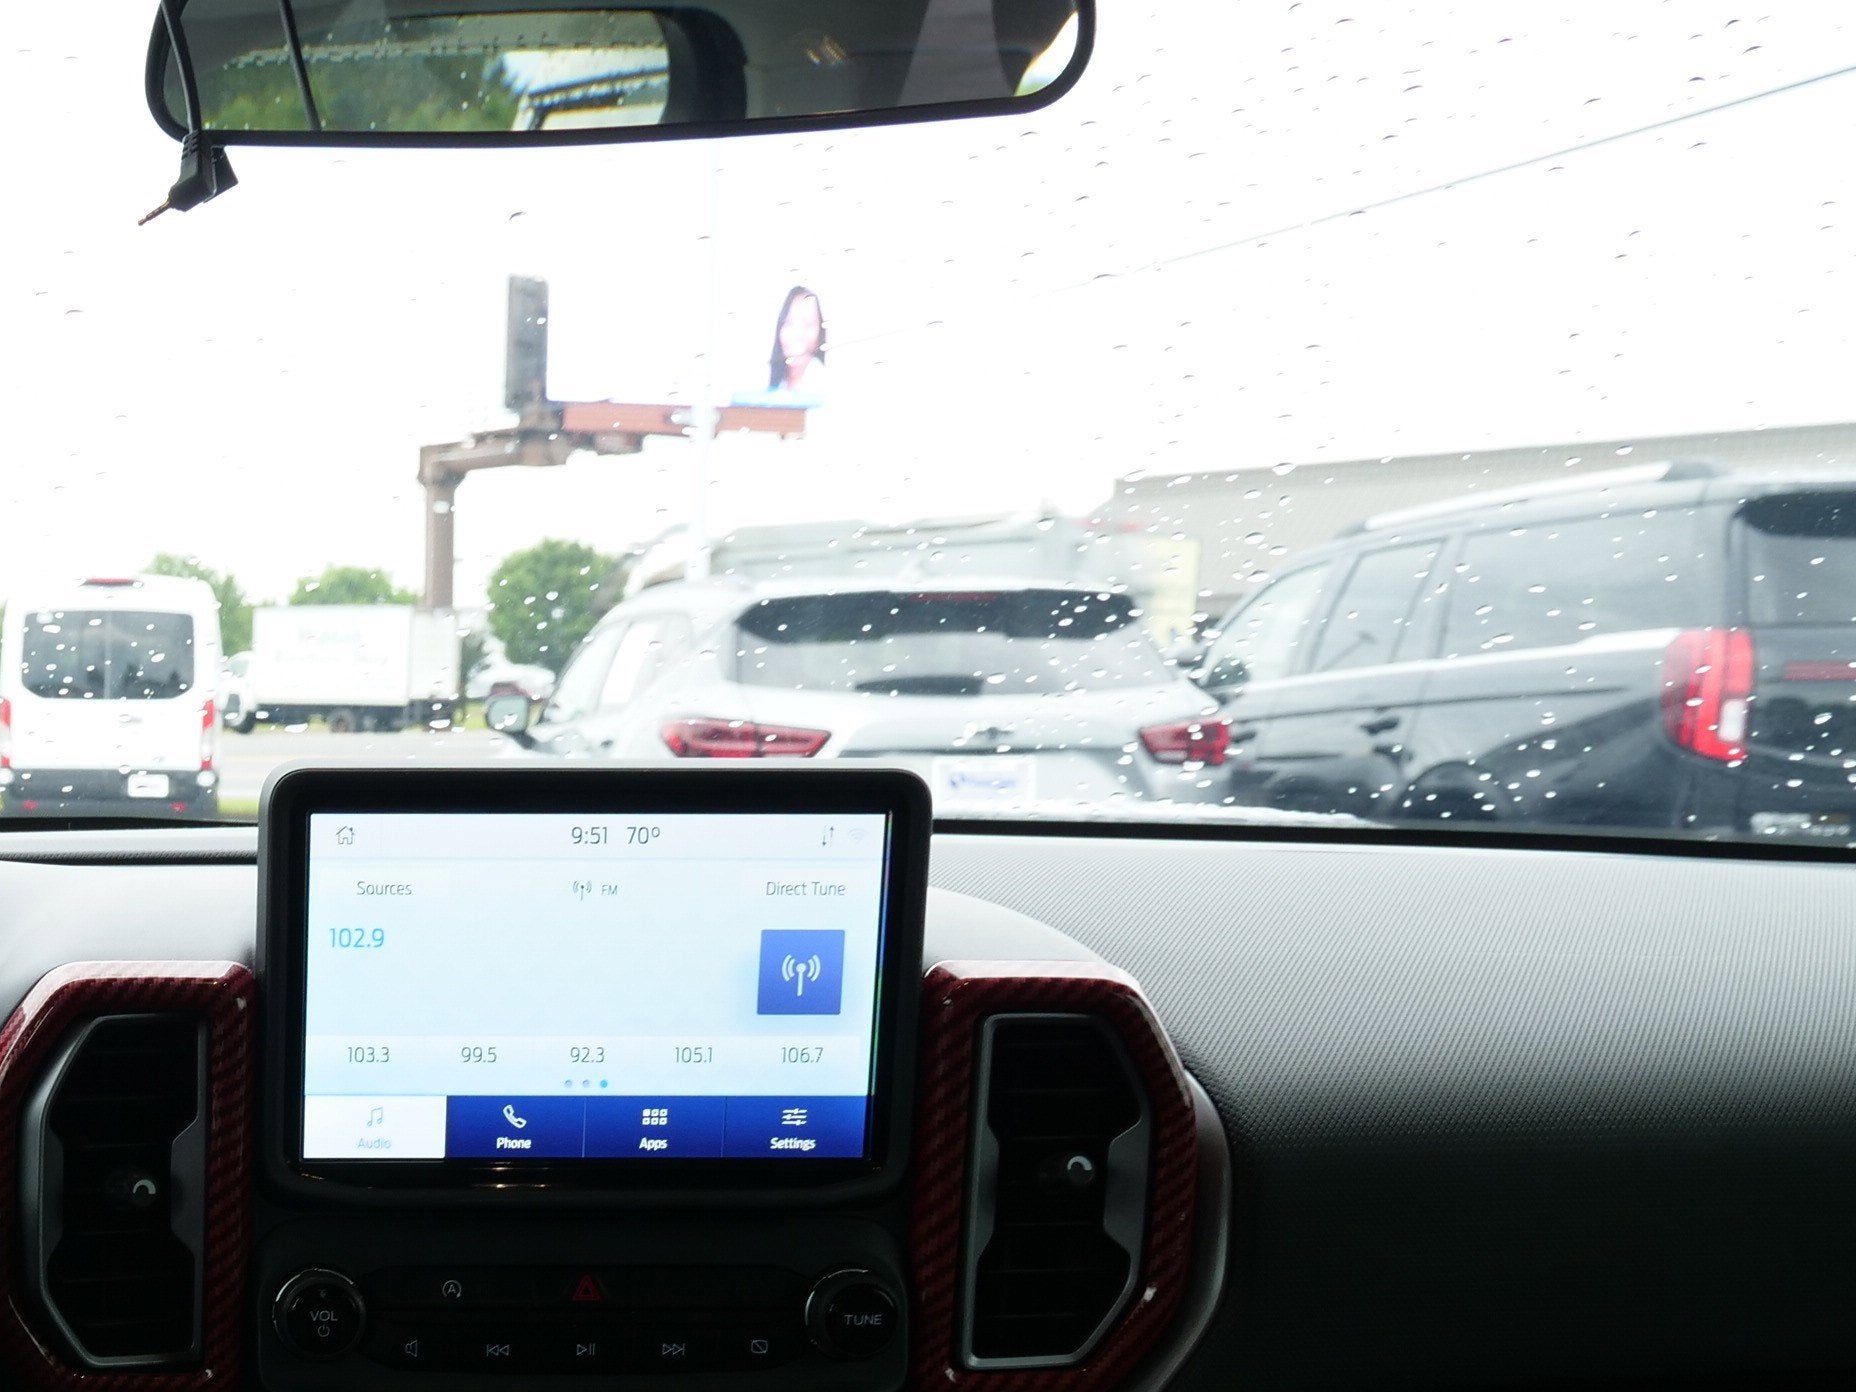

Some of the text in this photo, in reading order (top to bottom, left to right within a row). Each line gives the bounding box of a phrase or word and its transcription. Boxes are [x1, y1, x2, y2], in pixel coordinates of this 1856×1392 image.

[571, 826, 608, 845] 9:51
[357, 880, 412, 896] Sources
[601, 884, 618, 896] FM
[766, 881, 846, 896] Direct Tune
[329, 928, 385, 948] 102.9
[347, 1047, 391, 1063] 103.3
[461, 1047, 497, 1063] 99.5
[570, 1047, 605, 1063] 92.3
[674, 1047, 713, 1063] 105.1
[781, 1047, 824, 1063] 106.7
[357, 1137, 391, 1149] Audio
[496, 1137, 532, 1150] Phone
[639, 1138, 668, 1151] Apps
[770, 1137, 816, 1151] Settings
[310, 1310, 338, 1322] VOL
[844, 1314, 883, 1325] TUNE
